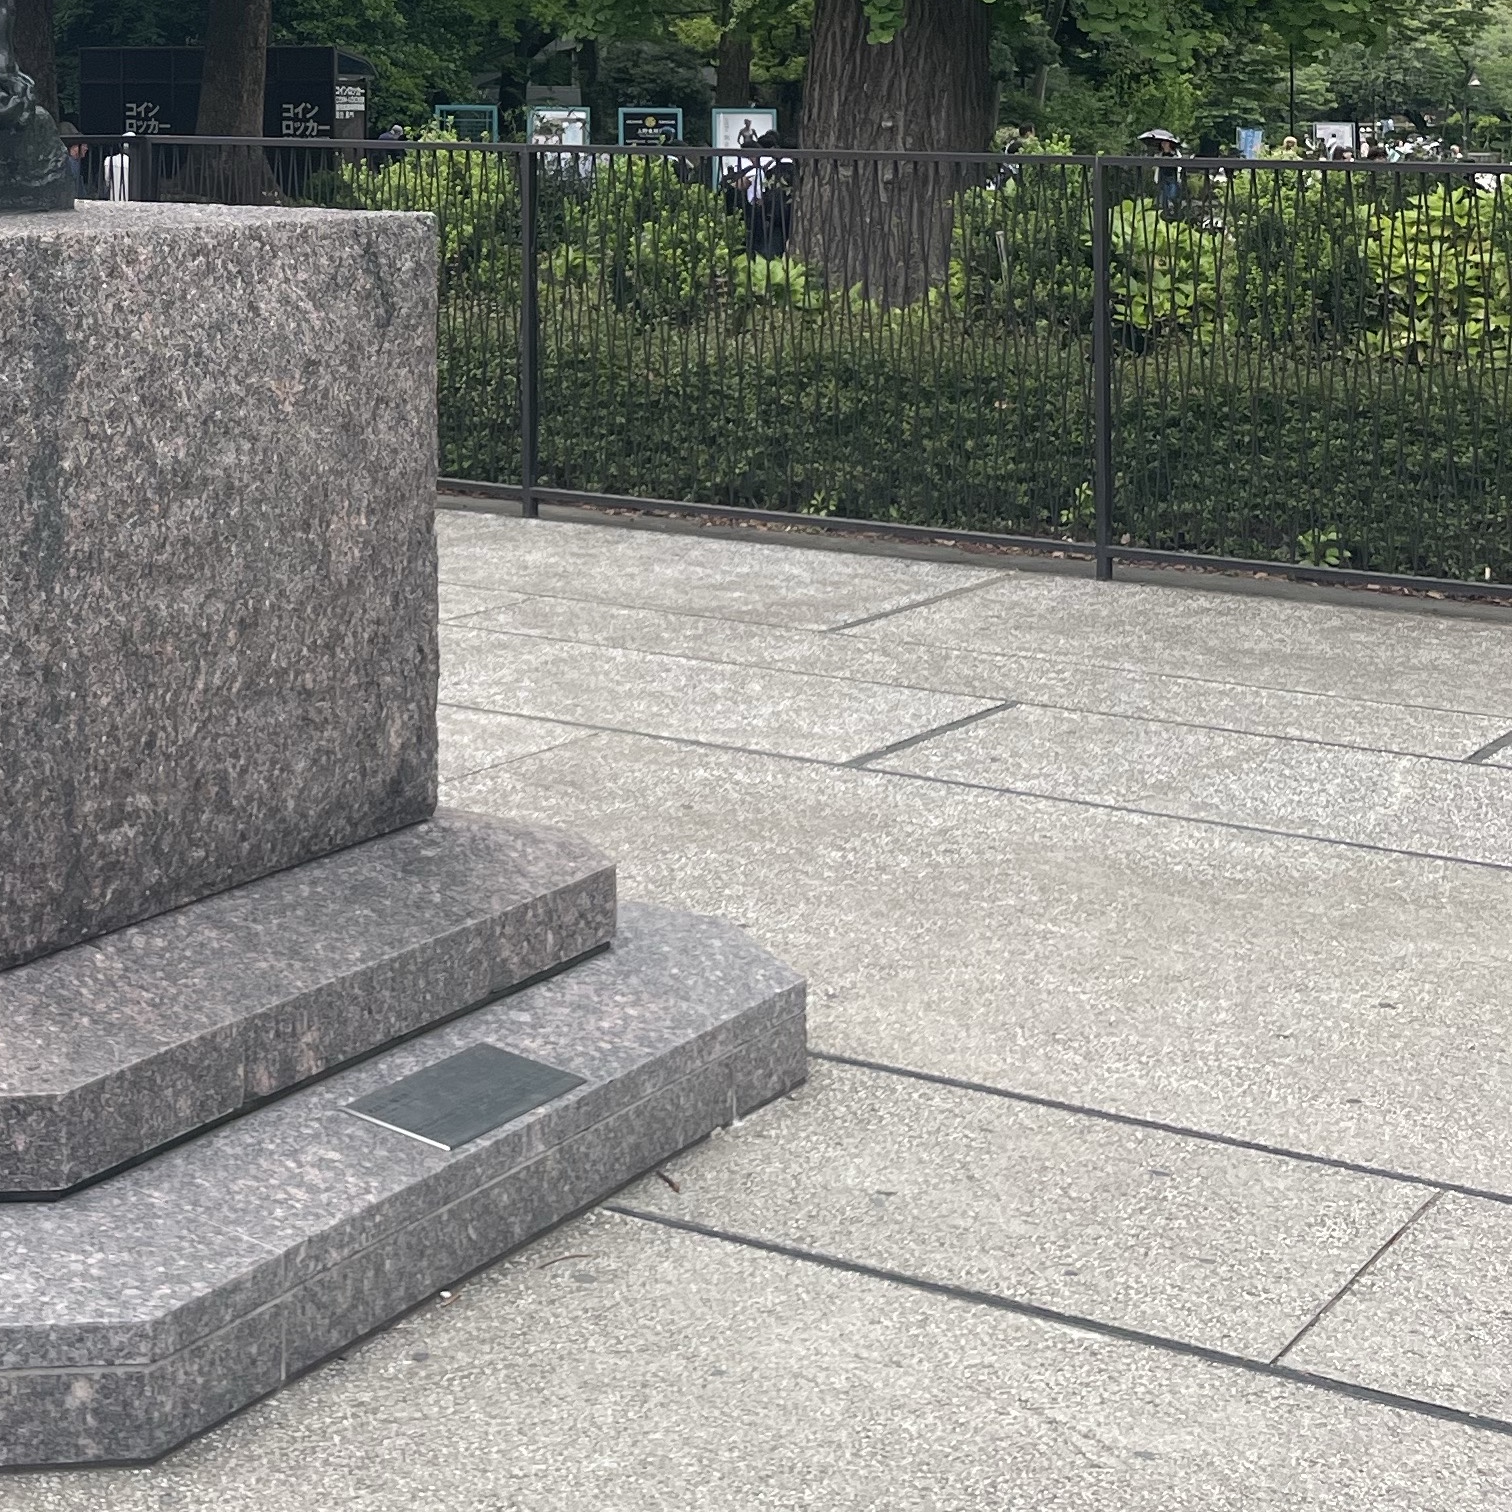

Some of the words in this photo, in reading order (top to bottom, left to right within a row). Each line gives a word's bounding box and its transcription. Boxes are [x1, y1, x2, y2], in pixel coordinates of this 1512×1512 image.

[125, 102, 160, 118] コイン
[282, 102, 319, 118] コイン
[125, 118, 171, 133] ロッカー
[282, 118, 331, 135] ロッカー
